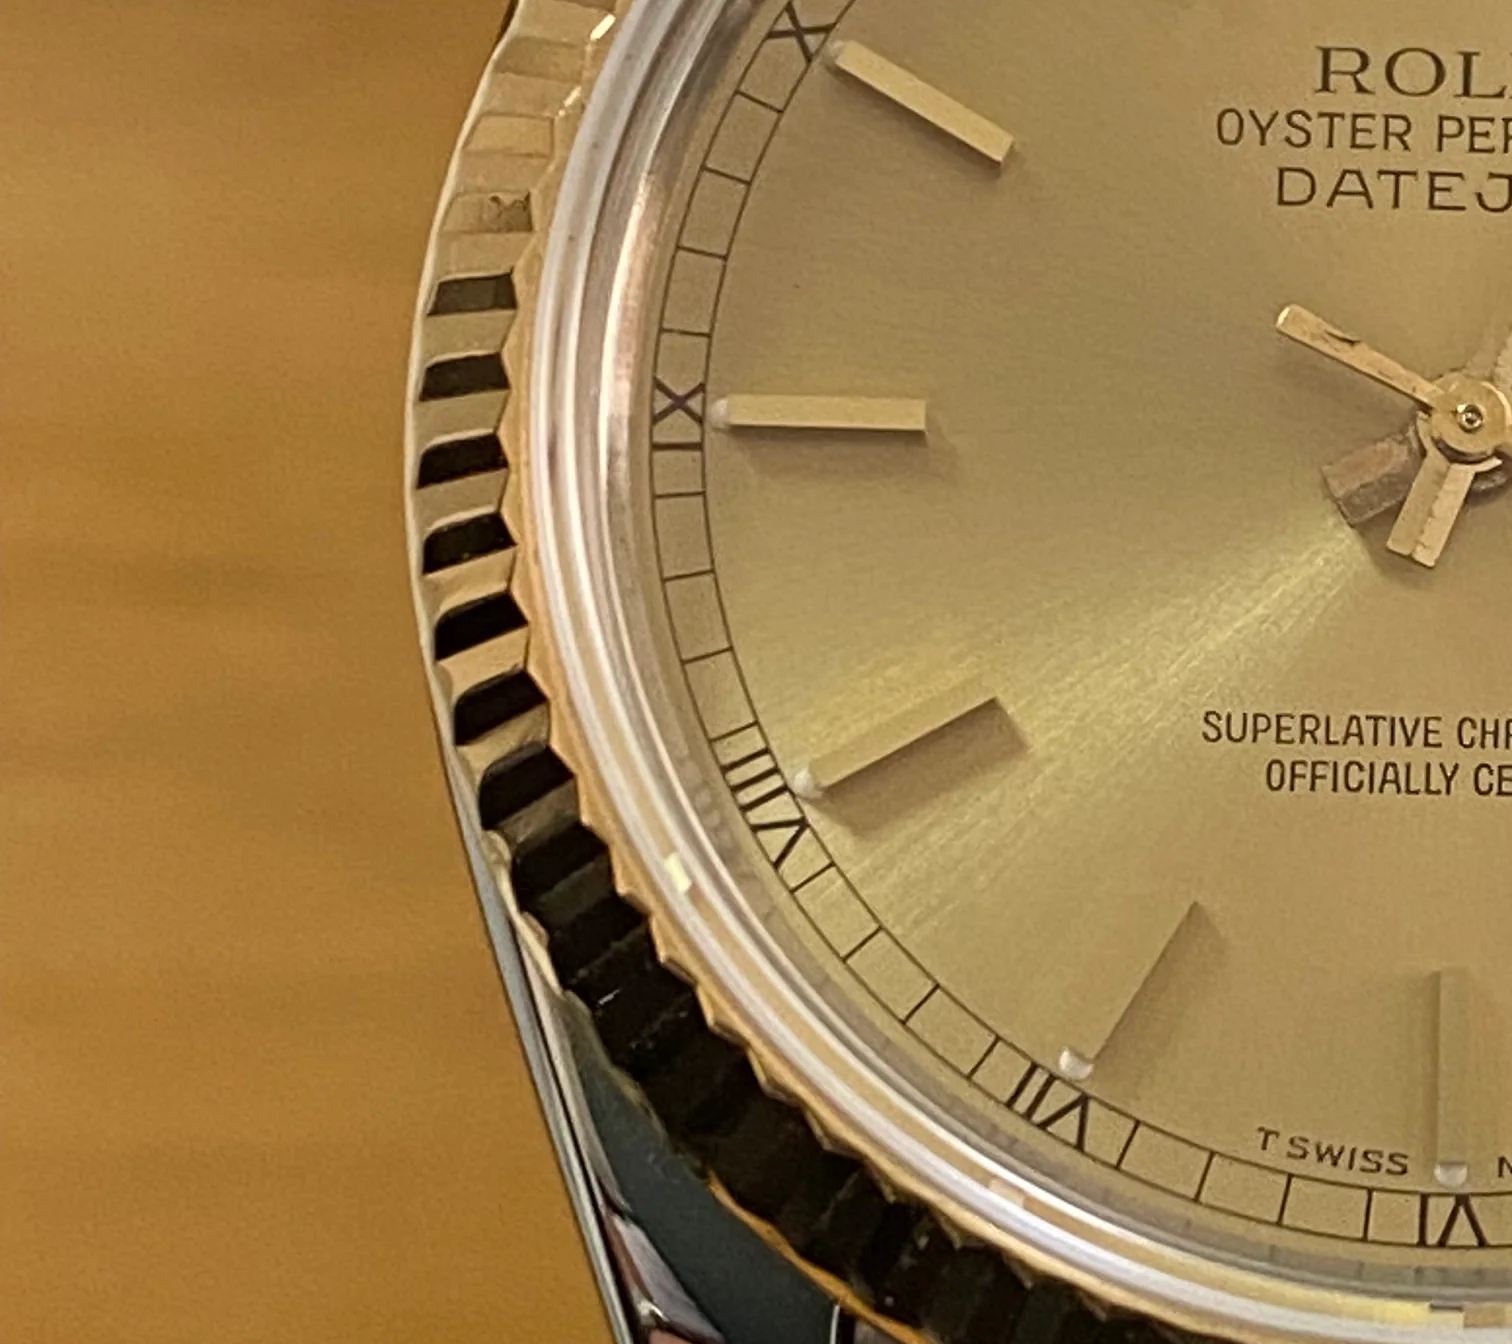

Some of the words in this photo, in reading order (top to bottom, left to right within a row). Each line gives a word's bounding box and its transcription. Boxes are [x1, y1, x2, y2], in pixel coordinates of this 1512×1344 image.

[766, 1, 837, 64] X
[1216, 107, 1411, 153] OYSTER
[1201, 709, 1443, 748] SUPERLATIVE
[1265, 758, 1459, 797] OFFICIALLY
[1285, 1135, 1410, 1177] SWISS
